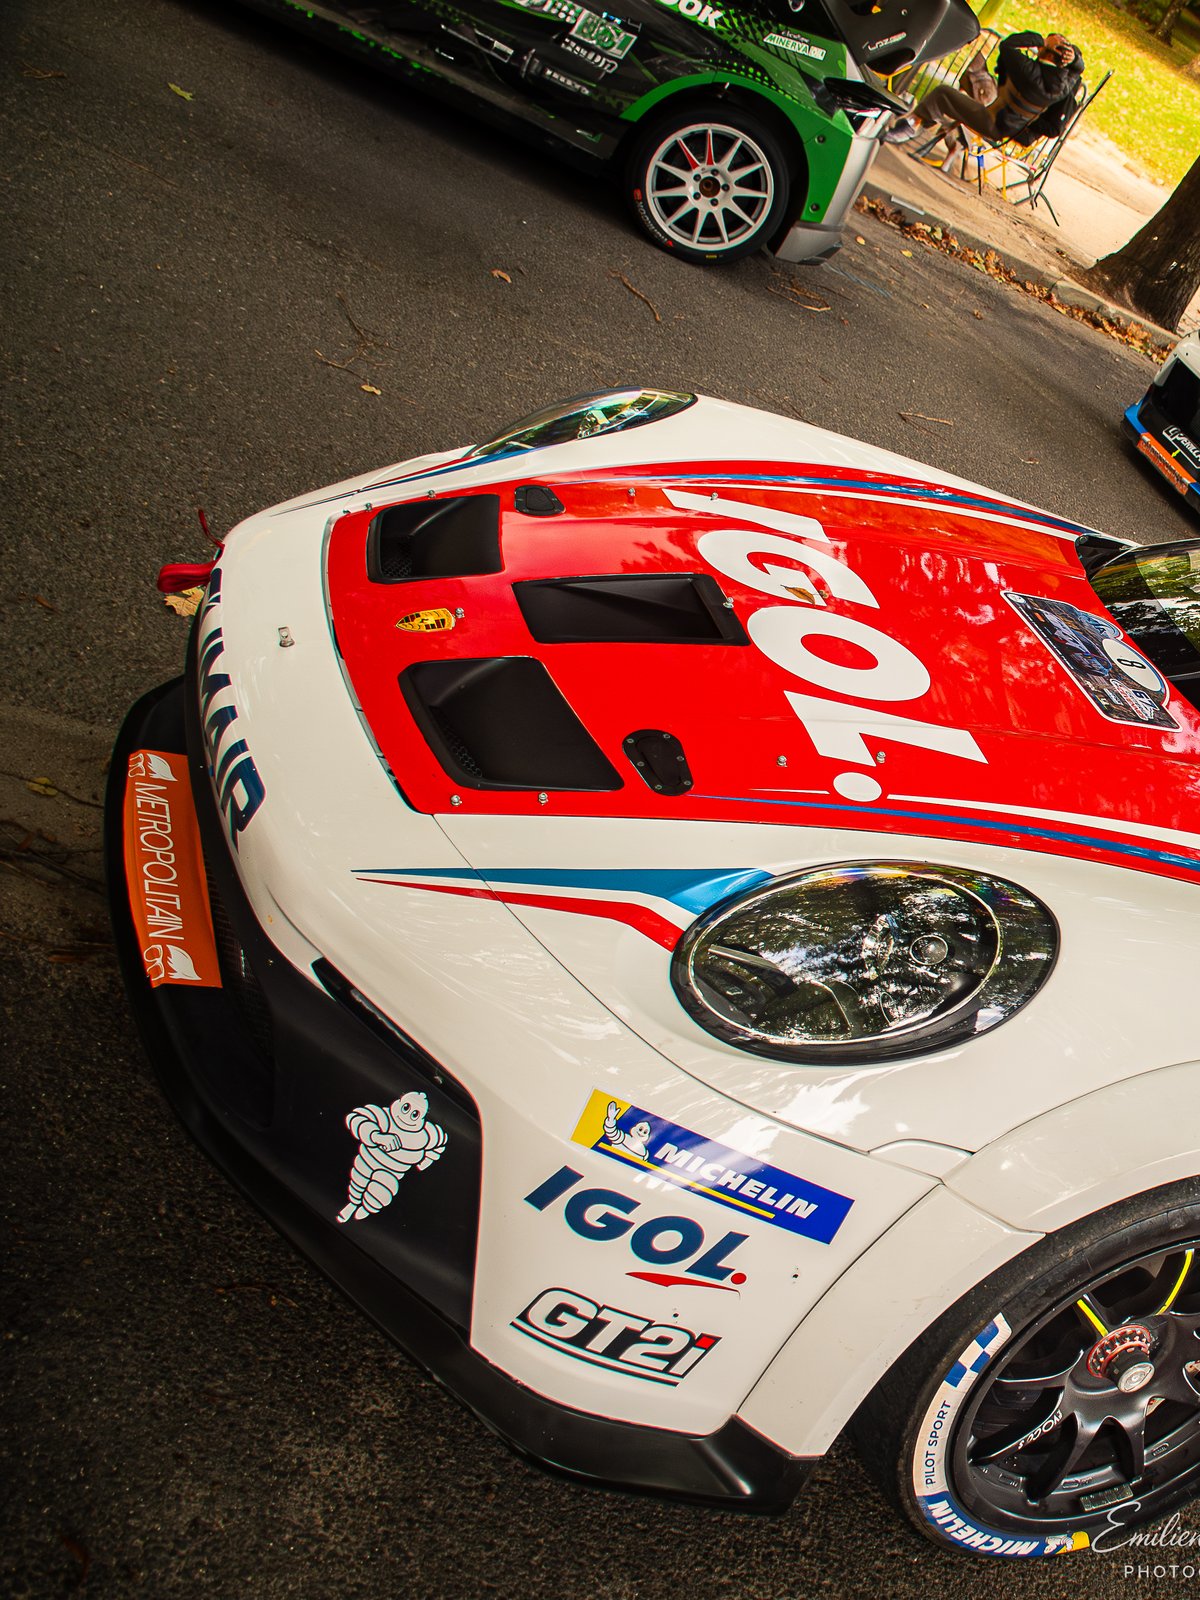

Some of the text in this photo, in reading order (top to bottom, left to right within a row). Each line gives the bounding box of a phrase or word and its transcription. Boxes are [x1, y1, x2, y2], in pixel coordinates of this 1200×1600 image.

[766, 33, 810, 55] MINERVA
[1116, 658, 1147, 670] 8
[134, 781, 184, 941] METROPOLITAIN
[653, 1141, 818, 1221] MICHELIN
[514, 1286, 723, 1380] GT2i
[924, 1400, 952, 1487] PILOT SPORT
[927, 1499, 1040, 1556] MICHELIN
